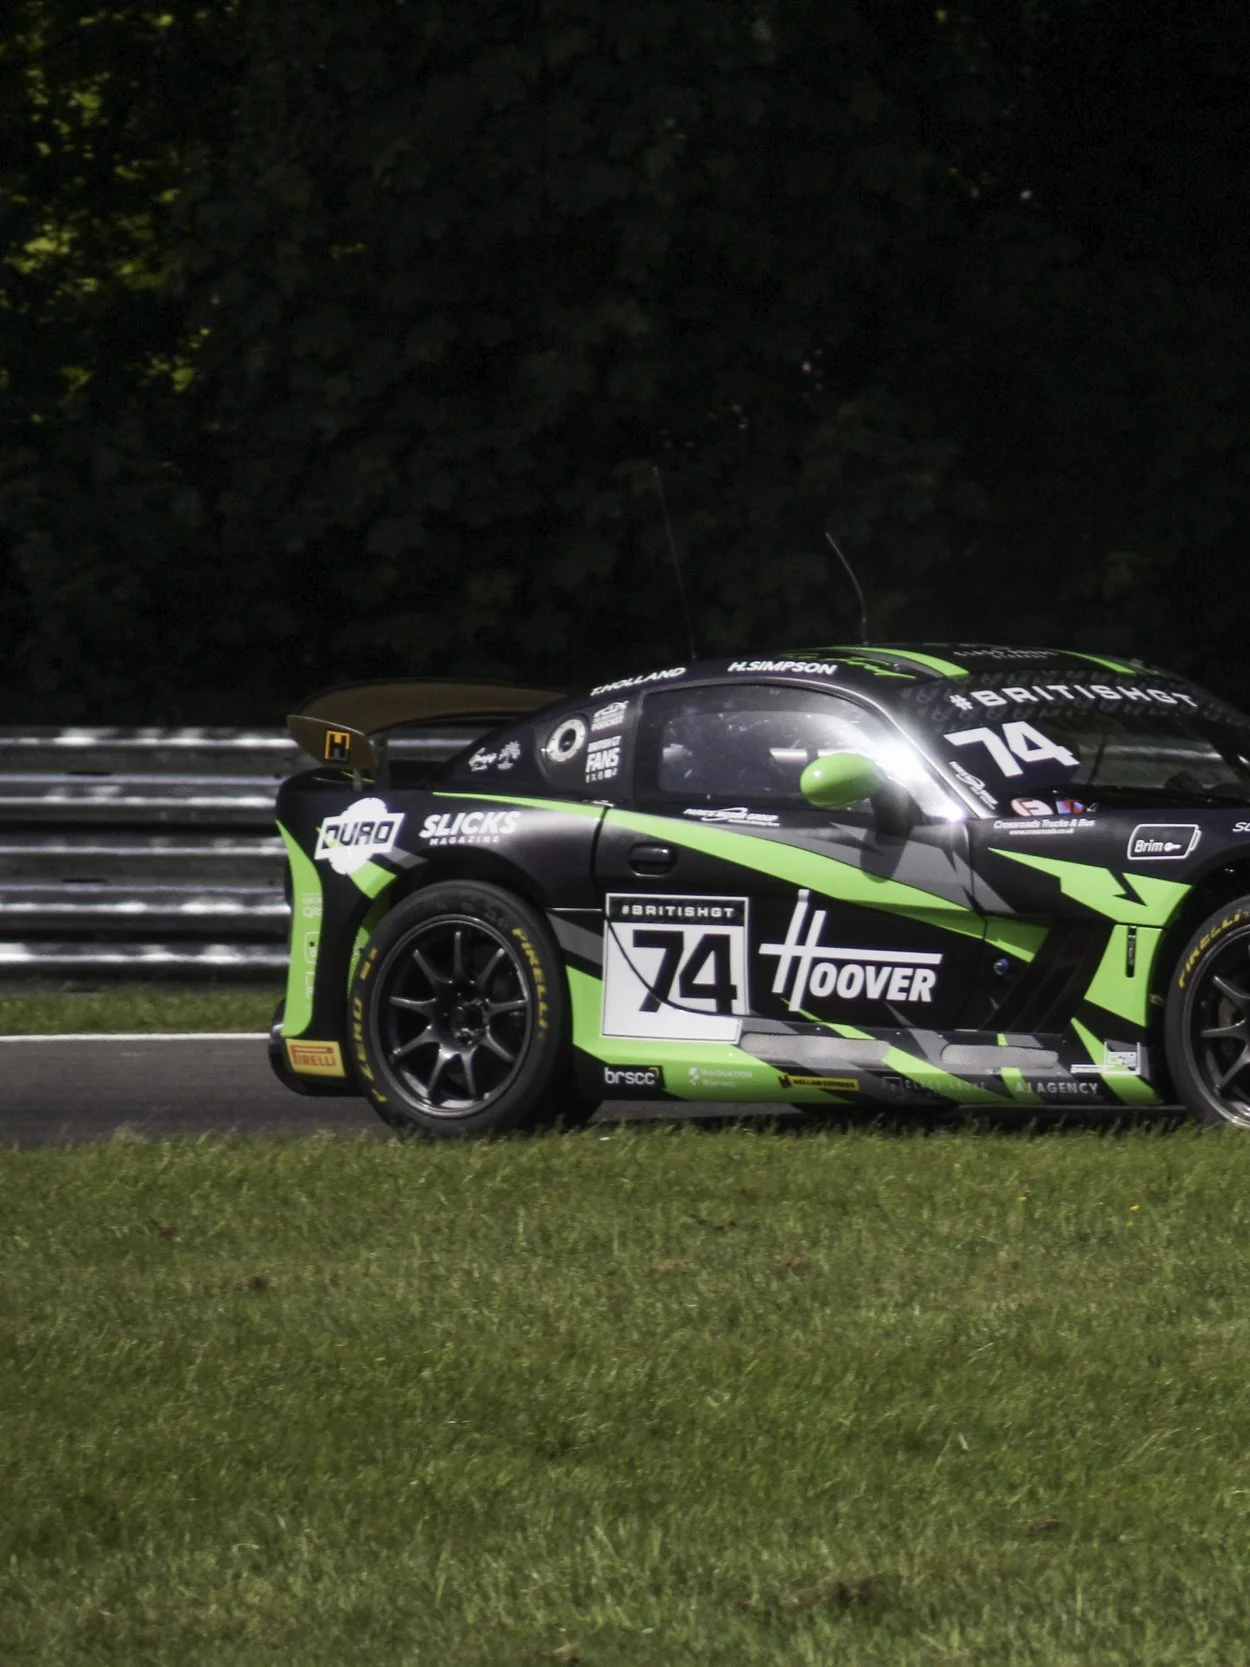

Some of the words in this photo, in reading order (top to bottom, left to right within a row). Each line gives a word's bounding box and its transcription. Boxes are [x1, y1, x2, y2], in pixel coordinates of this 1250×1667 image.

[727, 661, 838, 675] H.SIMPSON
[949, 684, 1199, 711] #BRITISHGT
[585, 747, 621, 773] FANS
[944, 721, 1081, 778] 74
[418, 811, 522, 838] SLICKS
[429, 835, 500, 846] MAGAZINE
[1134, 839, 1164, 853] Brim
[621, 904, 735, 918] #BRITISHGT
[758, 889, 943, 1012] HOOVER
[632, 929, 739, 1016] 74
[290, 1045, 336, 1068] PIRELLI
[604, 1066, 656, 1086] brscc
[1036, 1082, 1099, 1095] AGENCY
